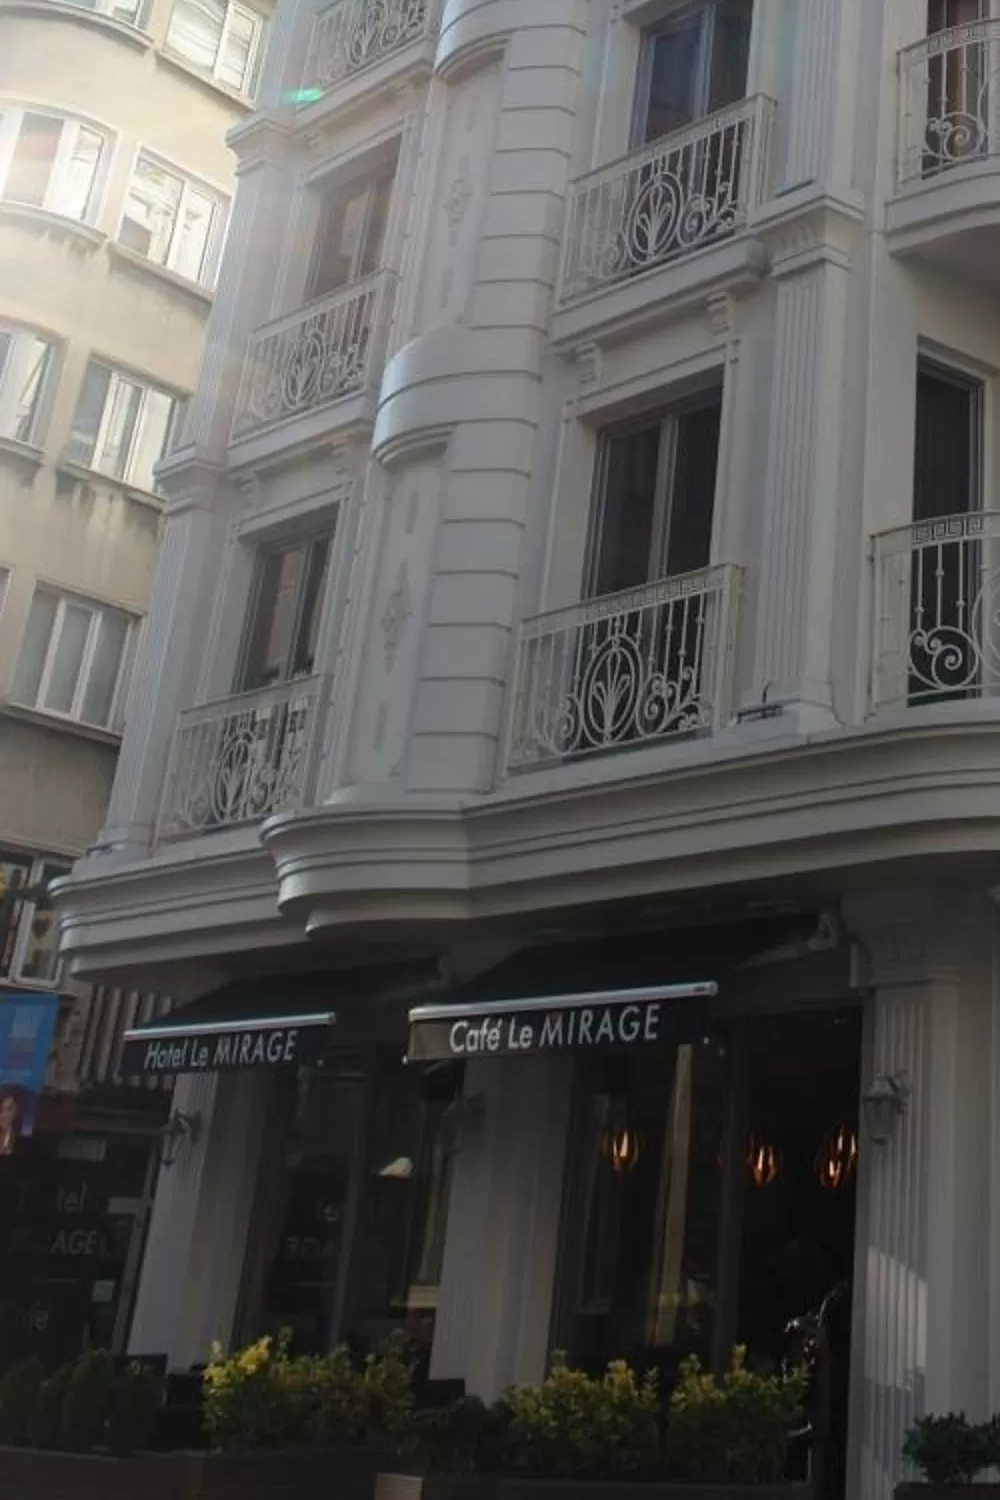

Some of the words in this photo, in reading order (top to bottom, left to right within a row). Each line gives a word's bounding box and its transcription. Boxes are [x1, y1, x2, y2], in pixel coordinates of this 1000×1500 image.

[143, 1037, 189, 1071] Hotel
[189, 1037, 209, 1068] Le
[212, 1029, 300, 1067] MIRAGE
[449, 1016, 503, 1054] Café
[507, 1016, 533, 1050] Le
[538, 1002, 661, 1048] MIRAGE
